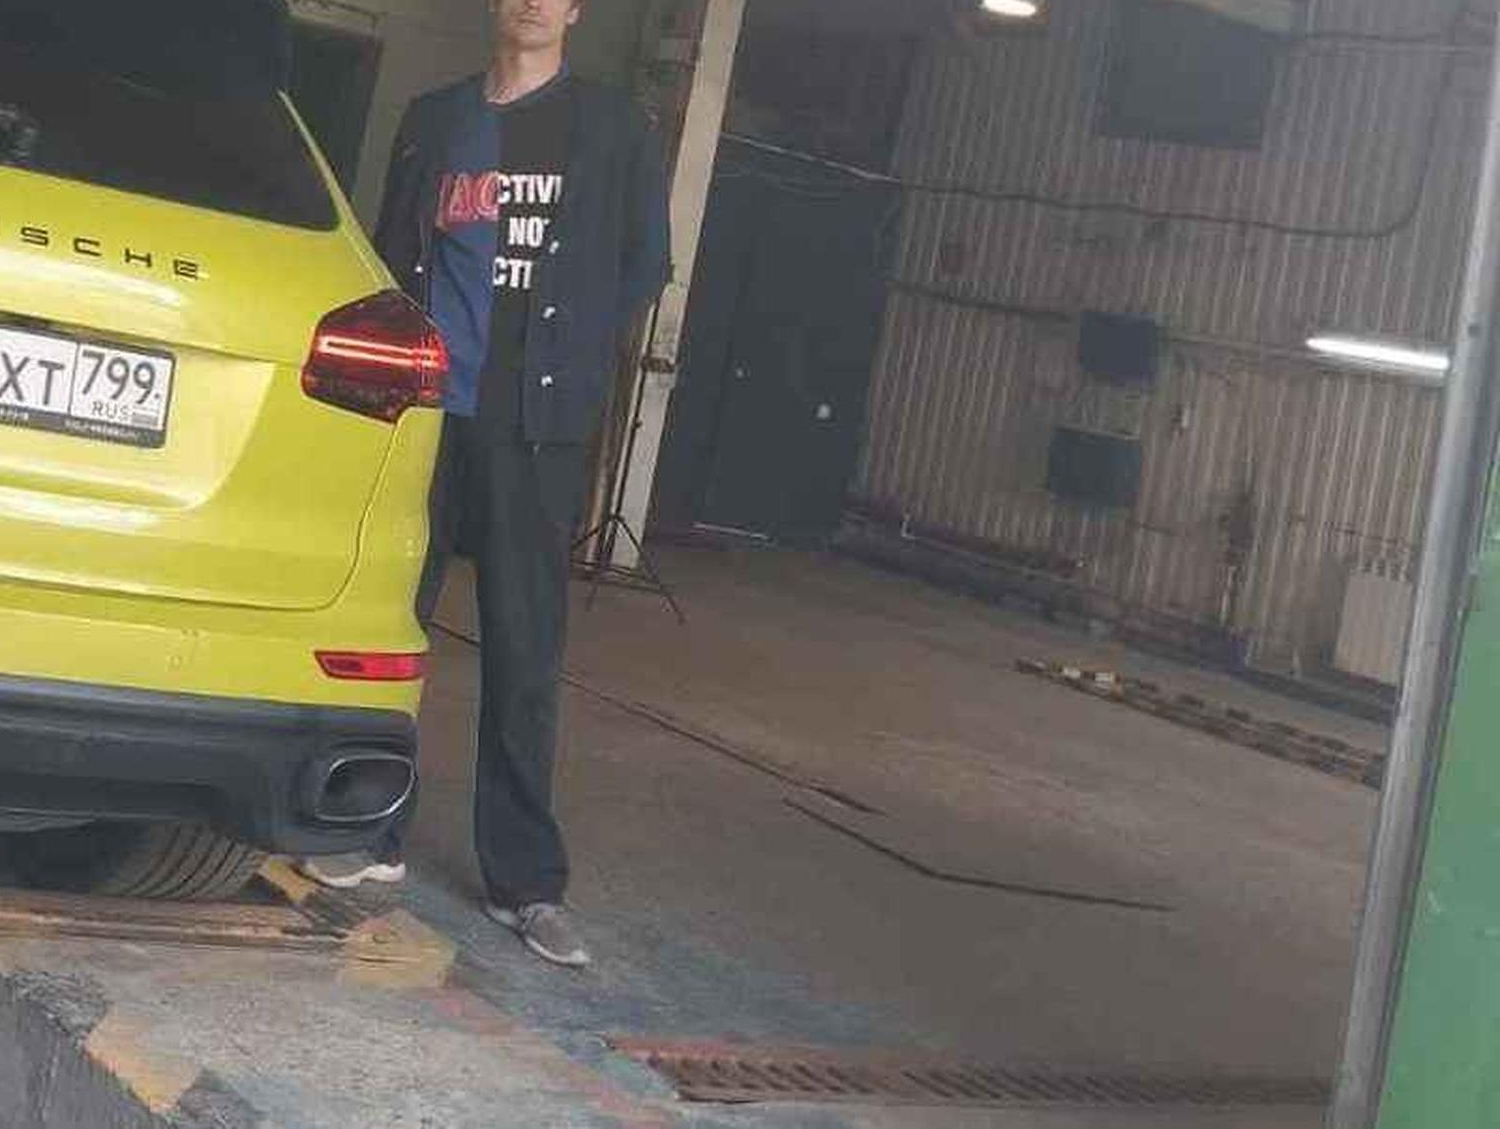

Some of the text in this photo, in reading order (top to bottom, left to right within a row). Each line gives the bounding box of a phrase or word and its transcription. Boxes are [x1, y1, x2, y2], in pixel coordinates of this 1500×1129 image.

[508, 217, 550, 248] NO
[81, 349, 157, 406] 799
[91, 400, 131, 422] RUS
